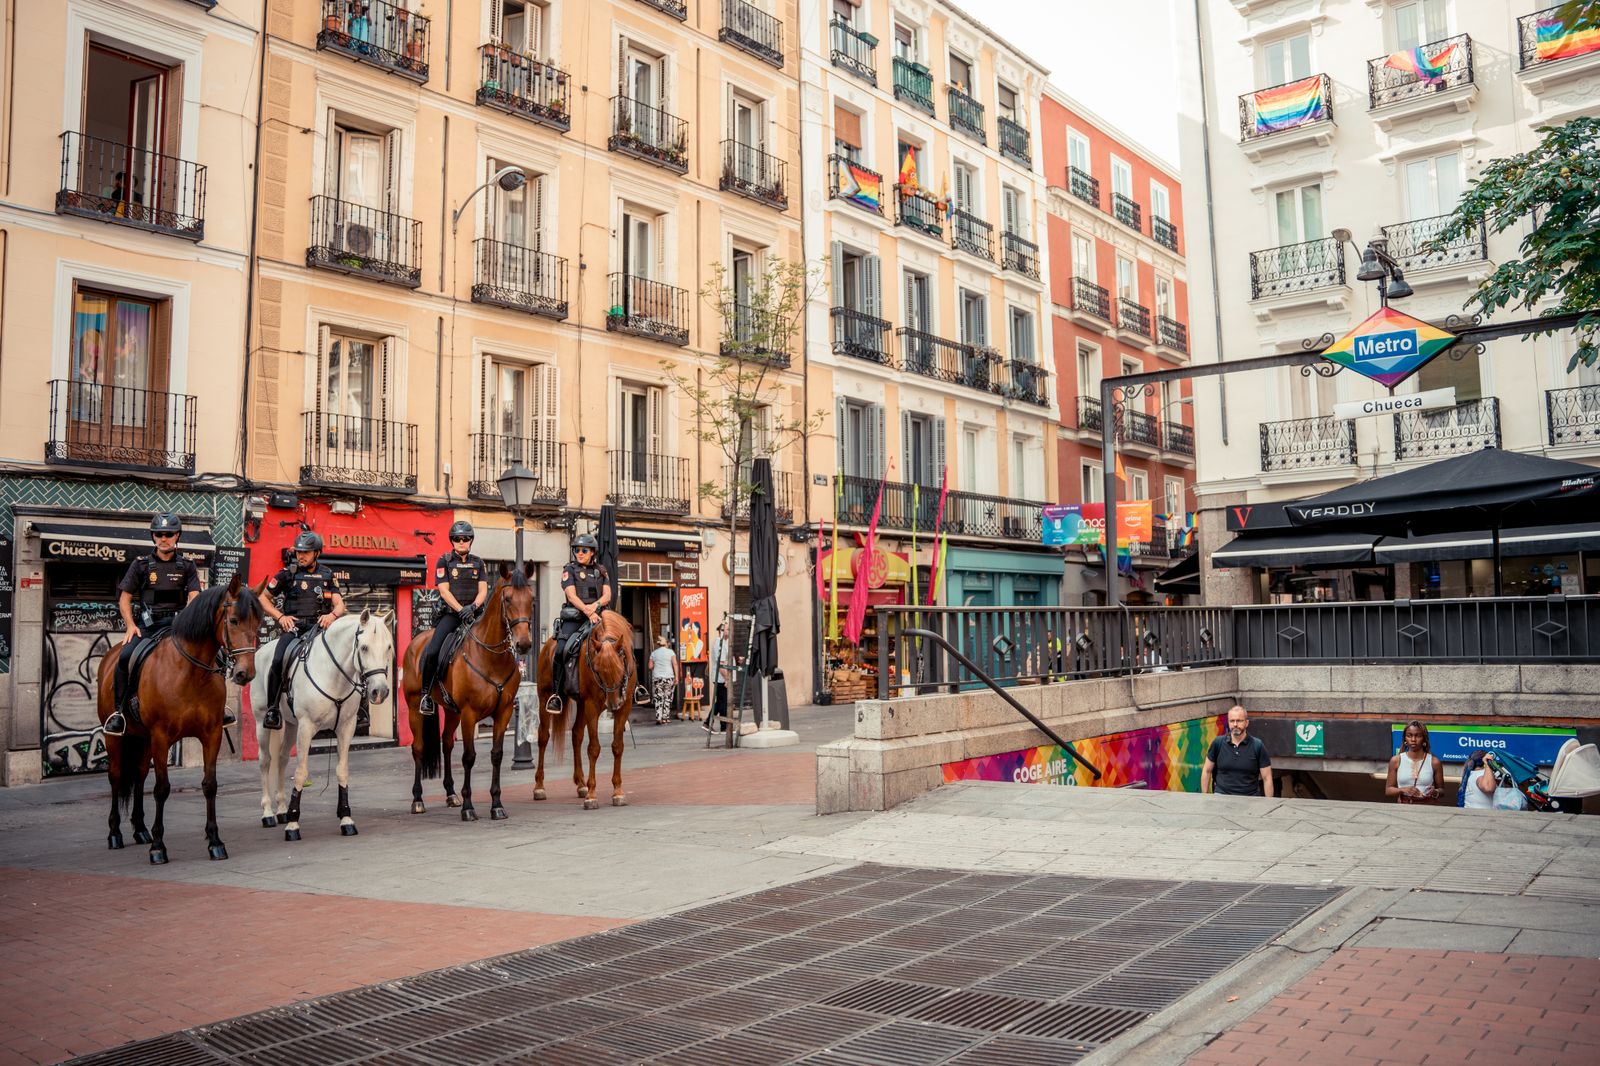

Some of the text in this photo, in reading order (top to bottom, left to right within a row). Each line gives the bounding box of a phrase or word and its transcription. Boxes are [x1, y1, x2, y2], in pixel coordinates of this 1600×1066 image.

[1358, 336, 1413, 357] Metro
[1362, 396, 1424, 414] Chueca
[1233, 507, 1253, 529] V
[1299, 502, 1376, 519] VERDOY
[329, 534, 400, 550] BOHEMIA
[1458, 736, 1507, 749] Chueca
[1013, 759, 1068, 783] COGE AIRE
